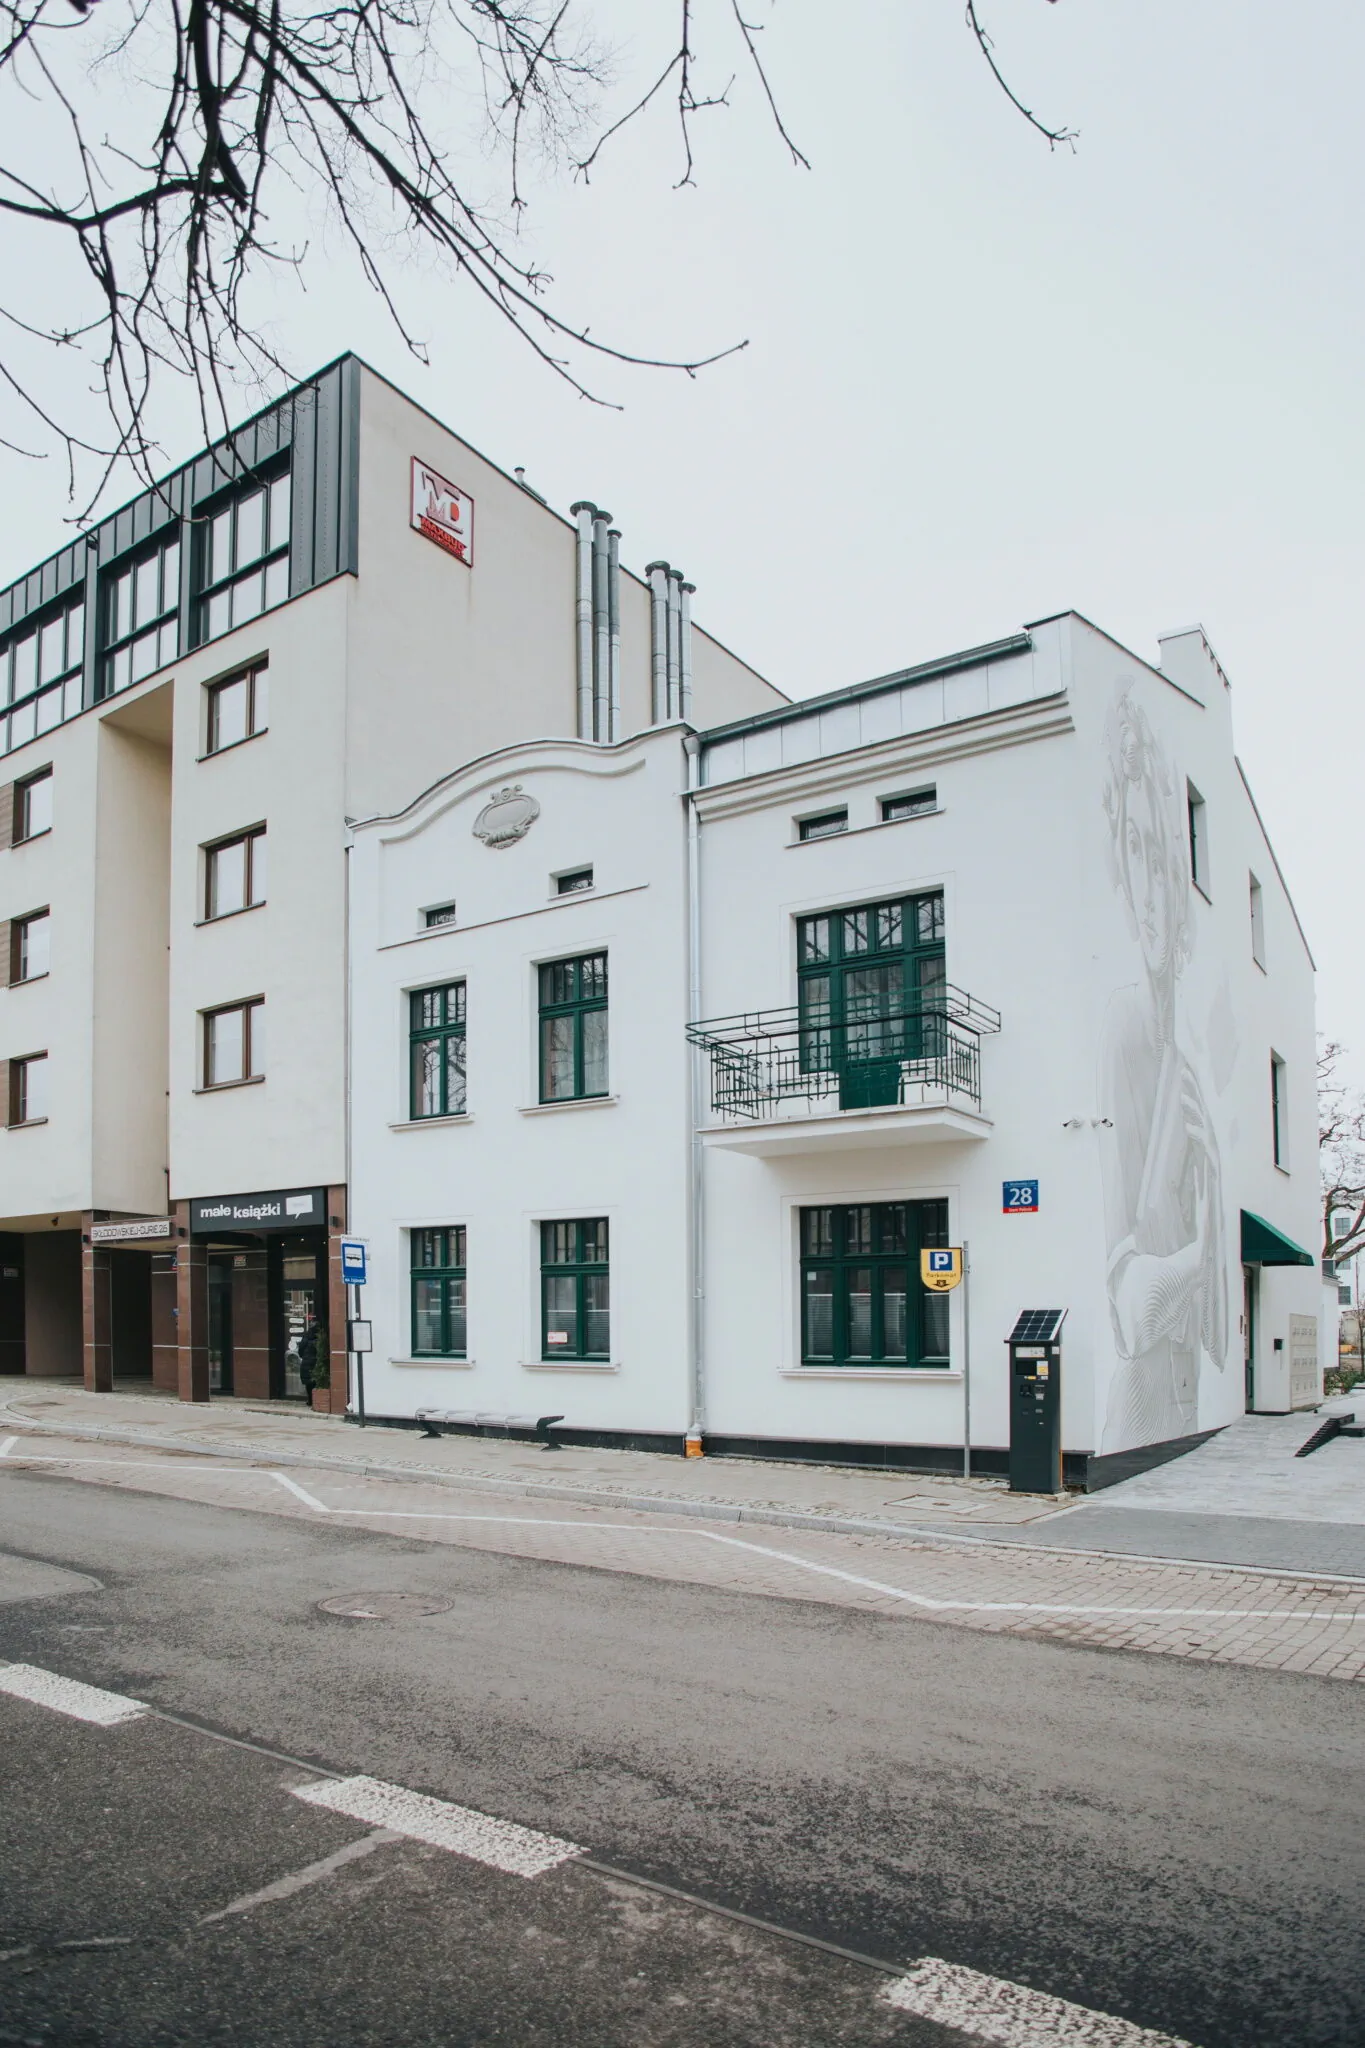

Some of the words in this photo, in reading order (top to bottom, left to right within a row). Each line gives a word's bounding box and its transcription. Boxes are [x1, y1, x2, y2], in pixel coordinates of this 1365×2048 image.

[1009, 1187, 1033, 1206] 28
[233, 1202, 281, 1221] książki
[934, 1252, 949, 1270] P
